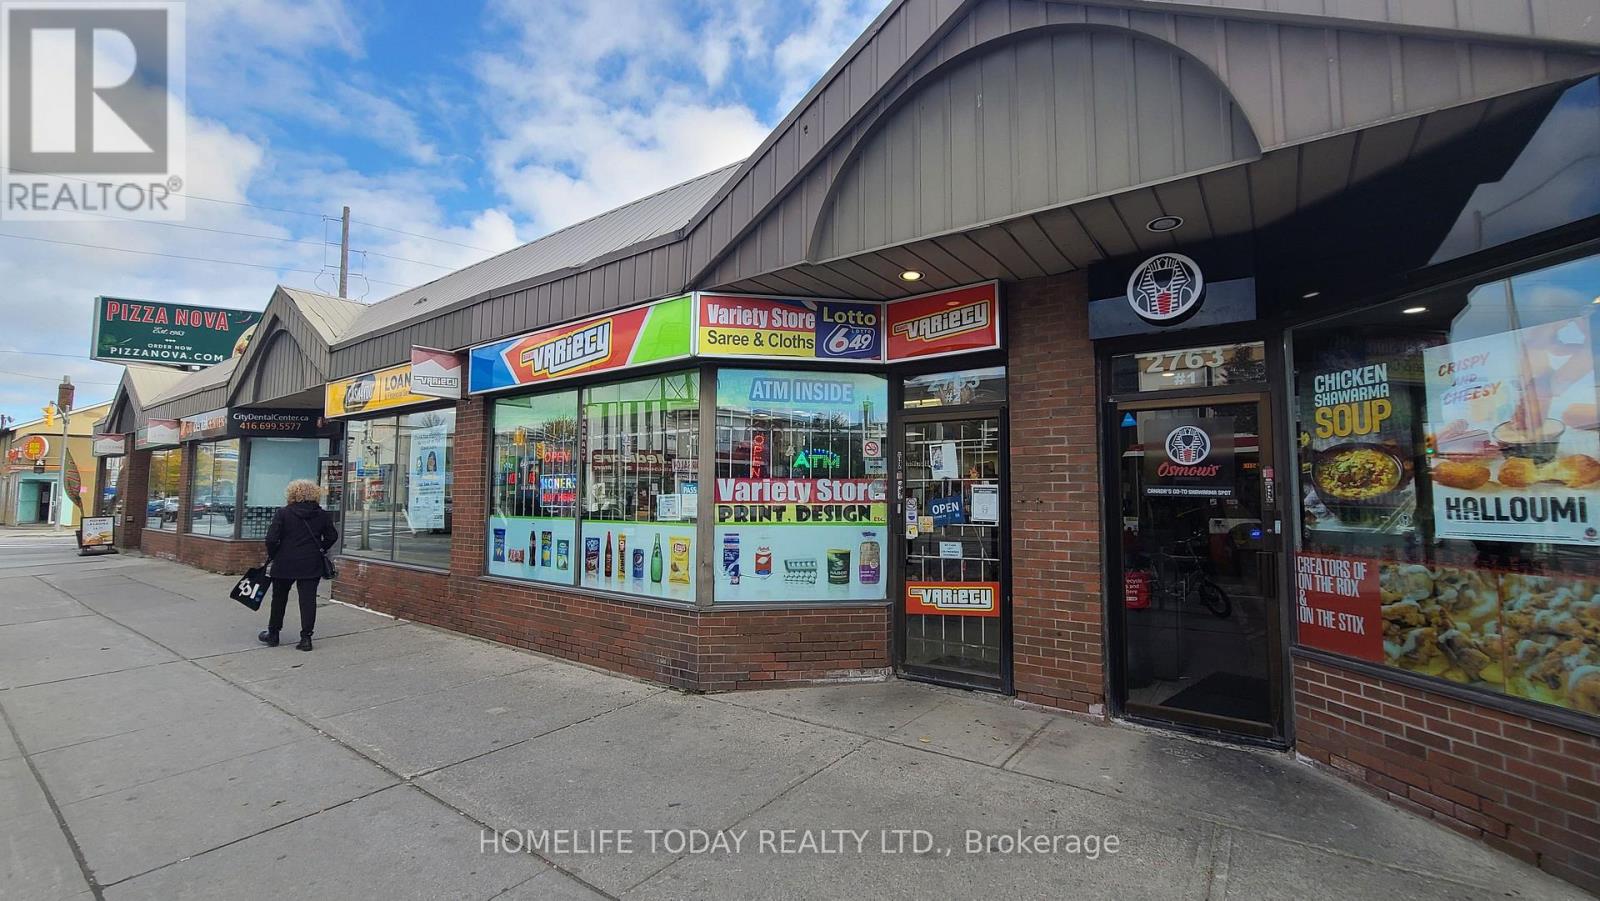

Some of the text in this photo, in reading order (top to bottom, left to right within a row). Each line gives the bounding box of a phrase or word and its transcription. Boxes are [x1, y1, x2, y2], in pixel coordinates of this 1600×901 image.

[106, 301, 229, 331] PIZZA NOVA
[707, 303, 815, 329] Variety Store
[823, 306, 876, 326] Lotto
[707, 330, 815, 350] Saree & Cloths
[829, 327, 872, 352] 6 49
[110, 347, 224, 361] PIZZANOVA.COM
[1146, 349, 1225, 373] 2763
[1438, 352, 1489, 376] CRISPY
[1173, 373, 1196, 385] #1
[1314, 362, 1388, 394] CHICKEN
[752, 380, 853, 402] ATM INSIDE
[1314, 383, 1390, 408] SHAWARMA
[1443, 380, 1502, 405] CHEESY
[233, 413, 309, 422] CityDentalCenter.ca
[239, 422, 301, 431] 416.699.5577
[1315, 398, 1392, 439] SOUP
[544, 451, 570, 463] OPEN
[752, 433, 765, 478] OPEN
[793, 450, 841, 469] ATM
[684, 486, 697, 494] PASS
[717, 479, 812, 503] Variety
[795, 505, 871, 522] DESIGN
[932, 501, 960, 515] OPEN
[1445, 496, 1588, 523] HALLOUMI
[1297, 556, 1367, 580] CREATORS OF
[1298, 573, 1360, 597] ON THE ROX
[1299, 589, 1308, 606] &
[1300, 606, 1365, 635] ON THE STIX
